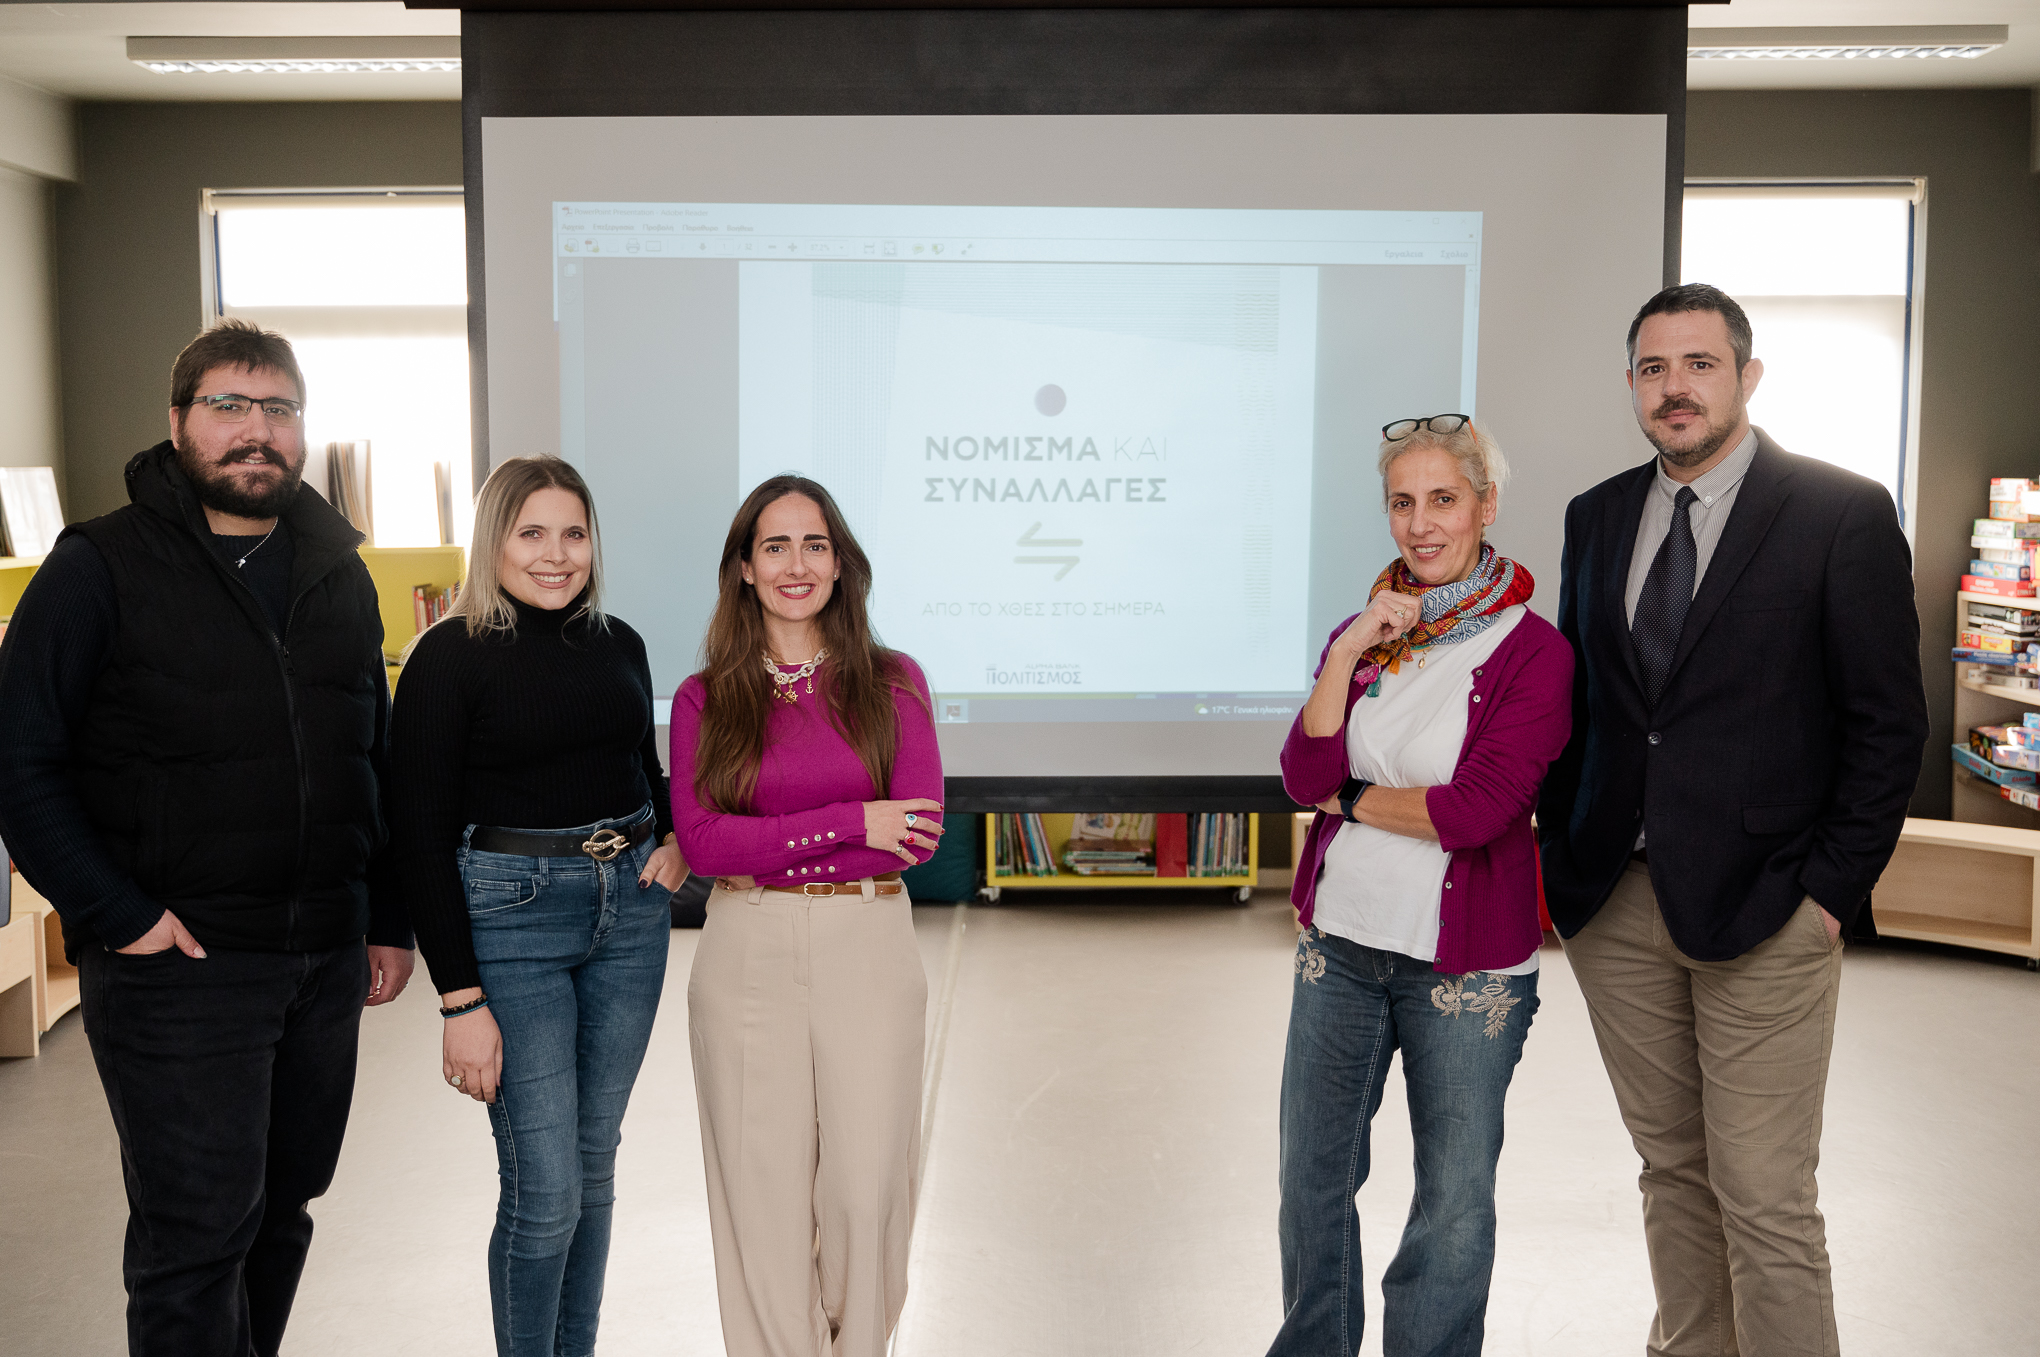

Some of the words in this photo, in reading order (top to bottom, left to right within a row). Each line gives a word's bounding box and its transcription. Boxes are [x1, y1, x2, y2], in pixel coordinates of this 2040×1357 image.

[574, 208, 612, 216] PowerPoint
[612, 208, 654, 216] Presentation
[685, 209, 709, 217] Reader
[925, 436, 1101, 461] ΝΟΜΙΣΜΑ
[1113, 436, 1167, 462] ΚΑΙ
[923, 477, 1167, 503] ΣΥΝΑΛΛΑΓΕΣ
[922, 602, 962, 616] ΑΠΟ
[969, 602, 992, 616] ΤΟ
[998, 602, 1045, 616] ΧΘΕΣ
[1051, 602, 1087, 616] ΣΤΟ
[1093, 602, 1166, 616] ΣΗΜΕΡΑ
[985, 668, 1082, 685] ΠΟΛΙΤΙΣΜΟΣ
